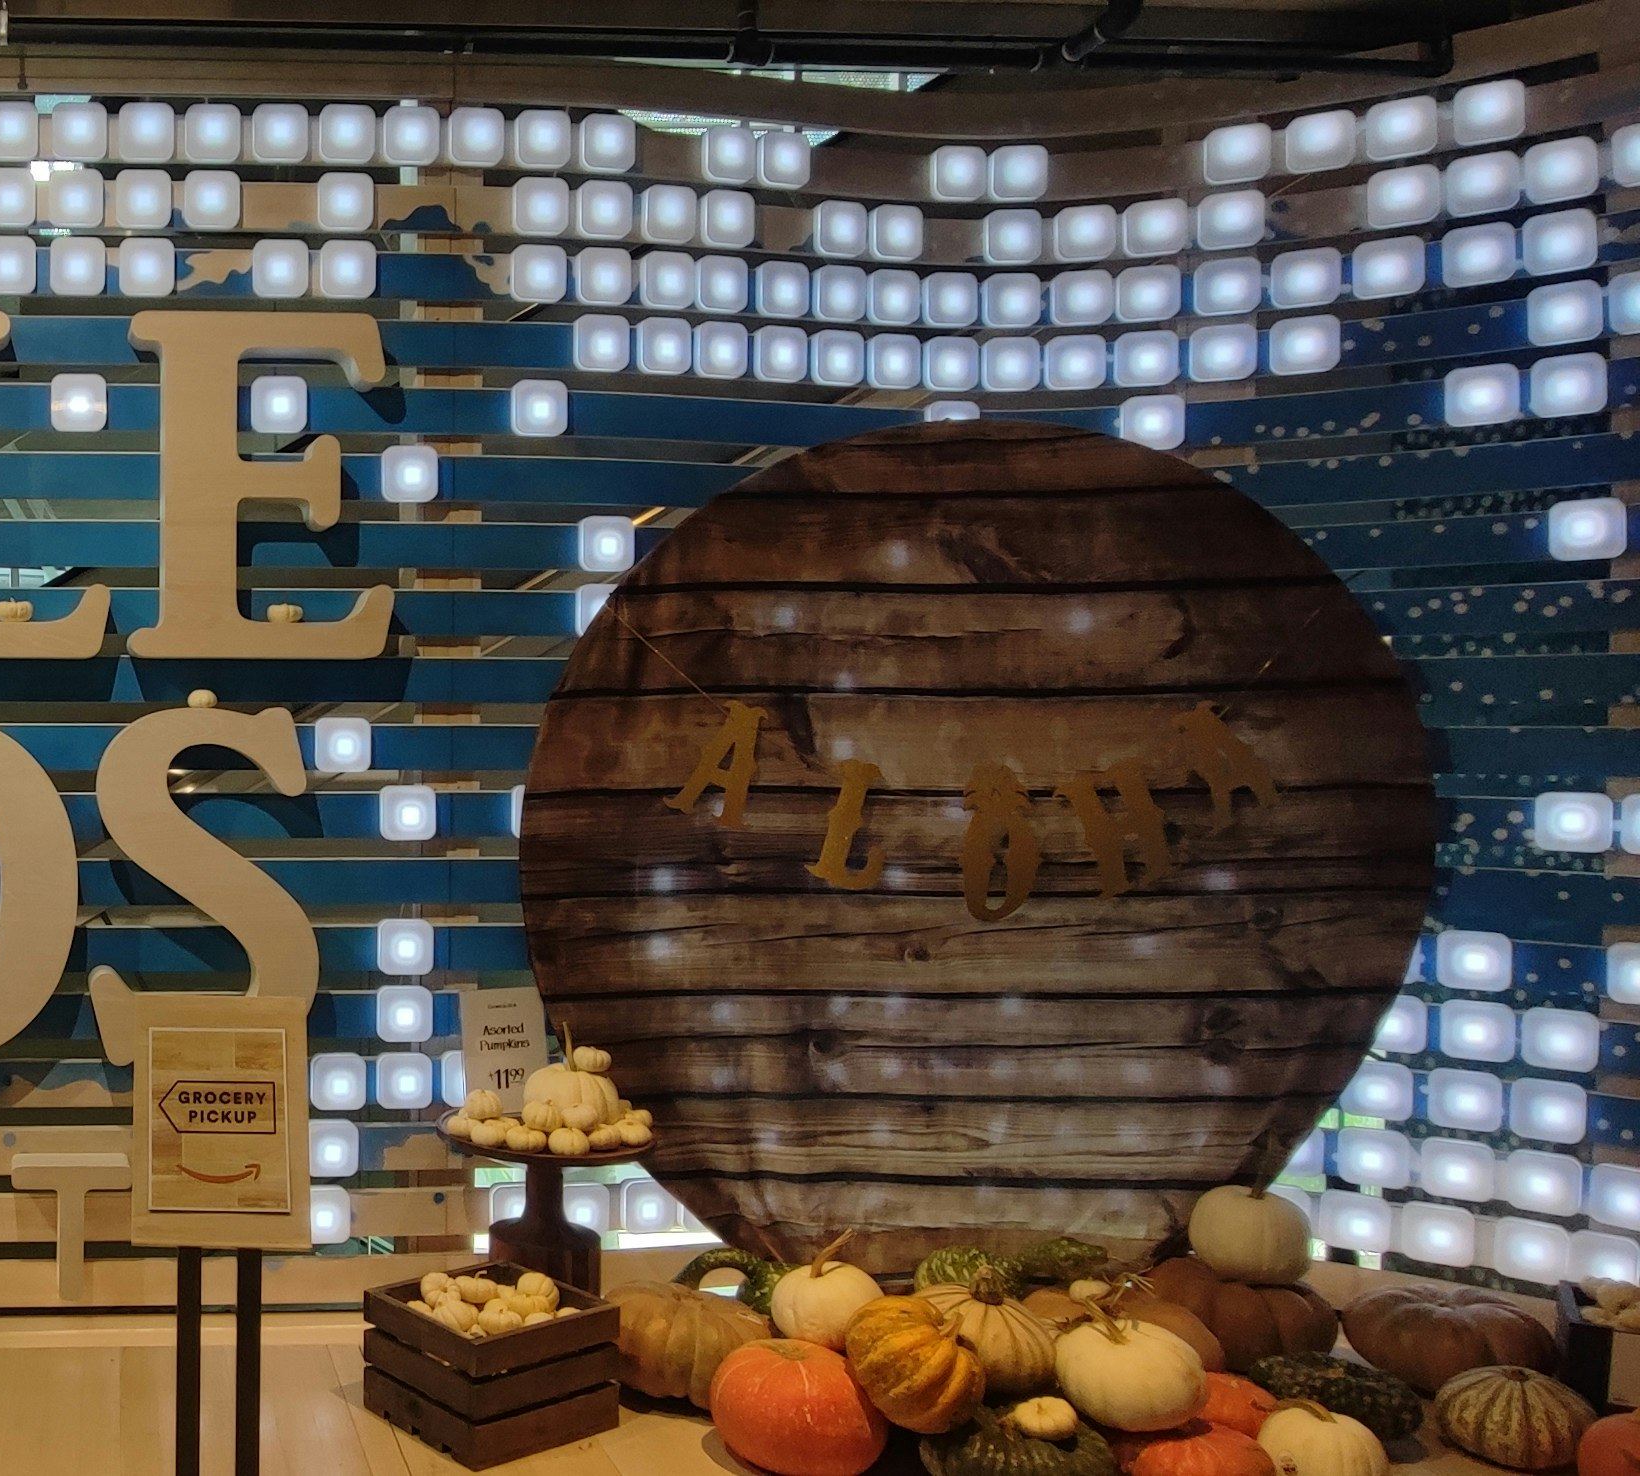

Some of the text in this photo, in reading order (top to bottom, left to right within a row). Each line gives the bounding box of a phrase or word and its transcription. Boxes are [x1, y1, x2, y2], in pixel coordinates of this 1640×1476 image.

[663, 700, 1278, 922] ALOHA
[177, 1090, 267, 1106] GROCERY
[188, 1109, 258, 1125] PICKUP
